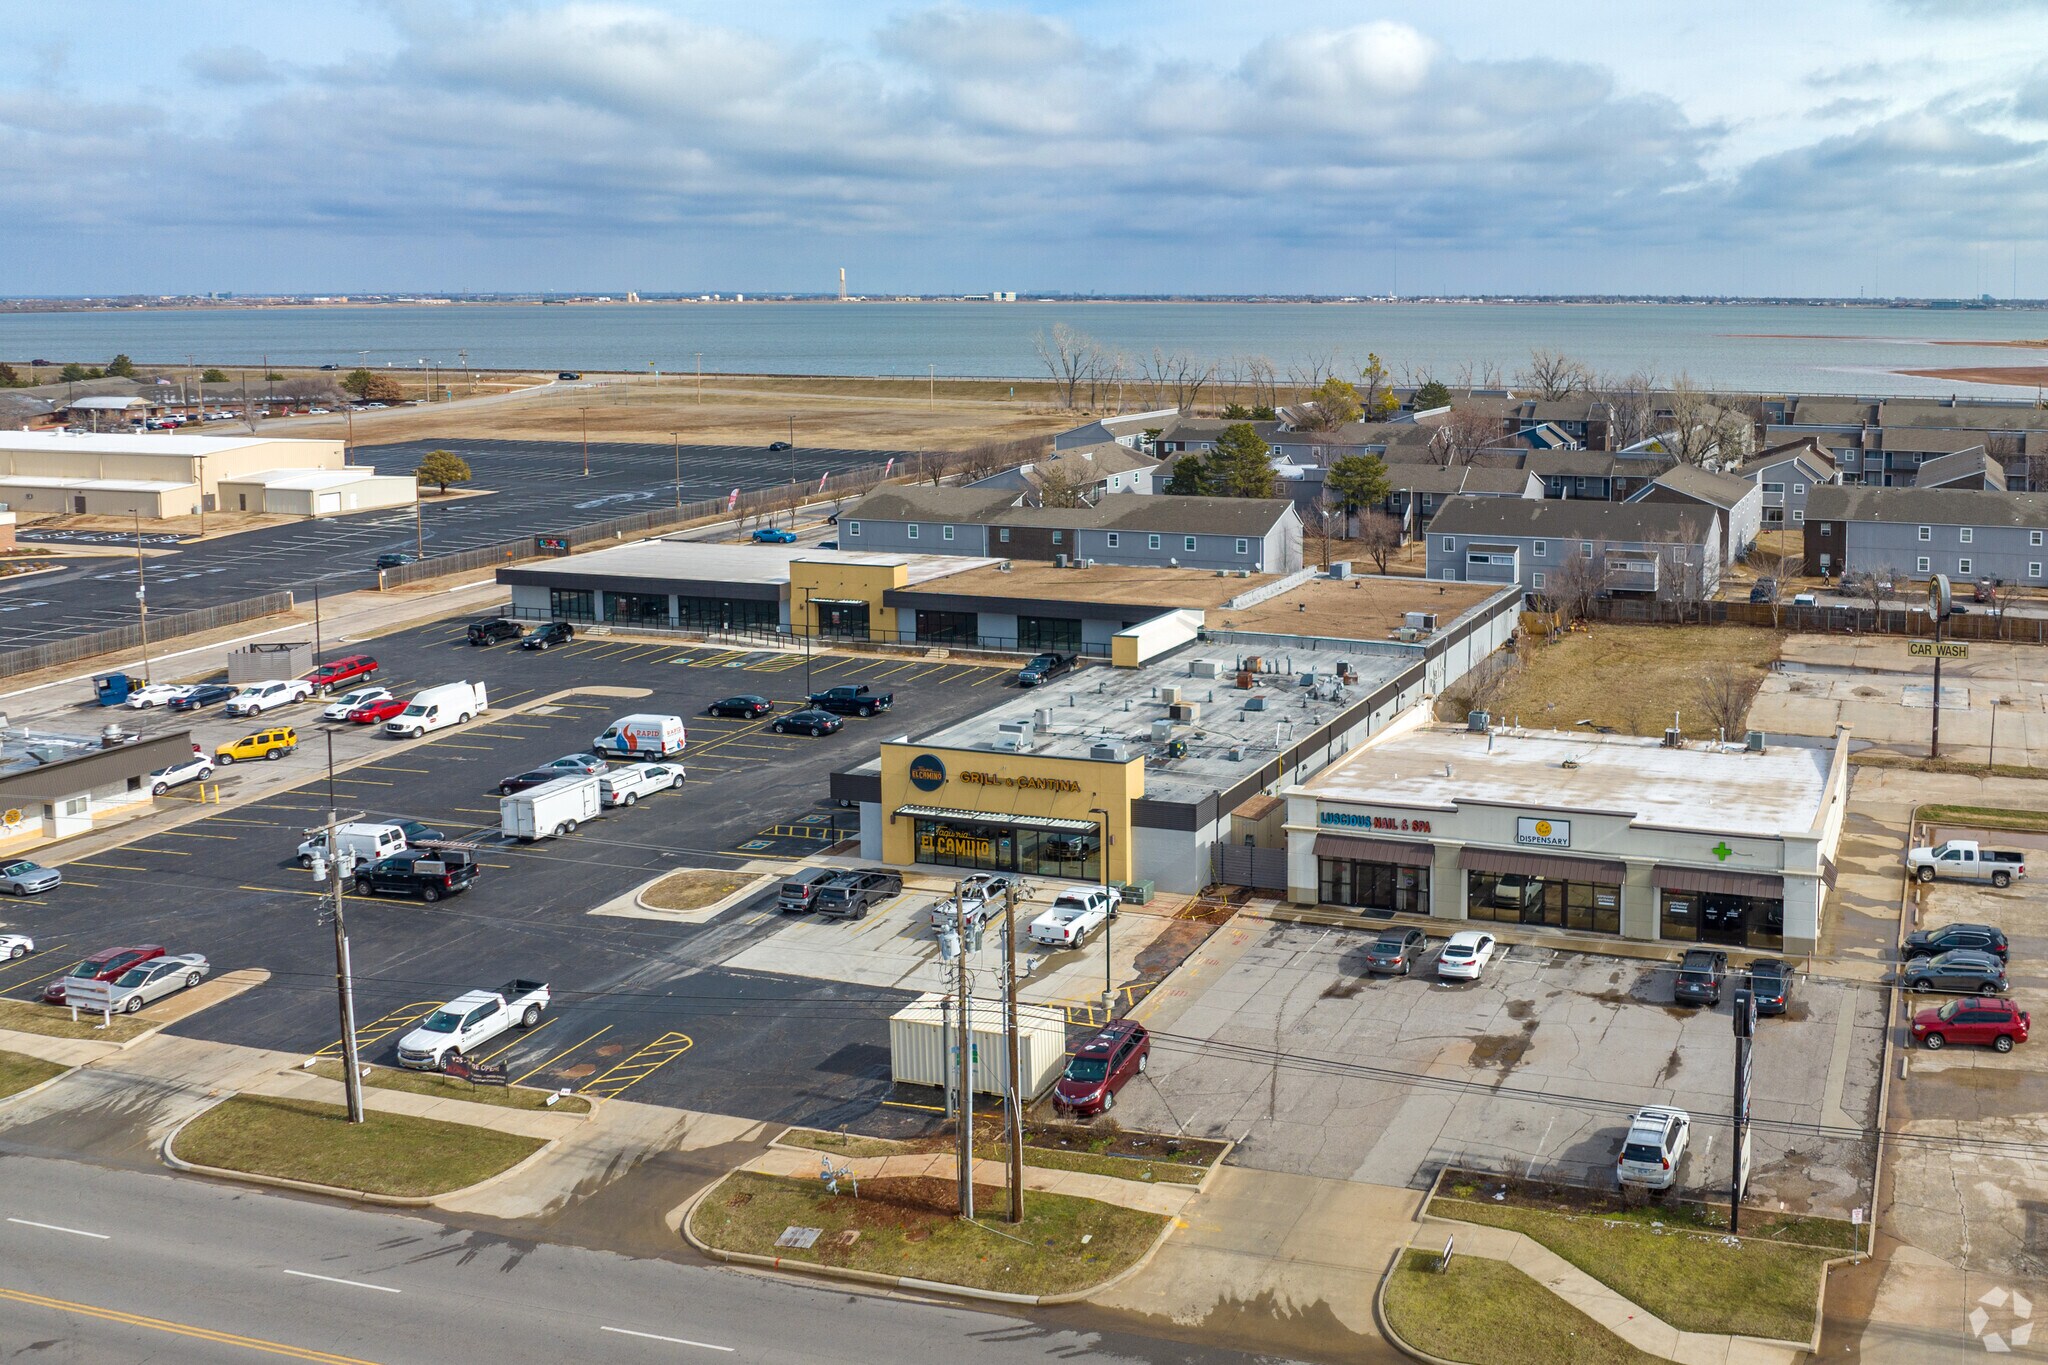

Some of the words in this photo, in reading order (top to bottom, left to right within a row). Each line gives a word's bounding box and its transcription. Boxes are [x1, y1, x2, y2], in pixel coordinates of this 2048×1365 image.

[1910, 644, 1932, 655] CAR
[1936, 645, 1967, 657] WASH
[636, 729, 660, 737] RAPID
[959, 771, 1002, 786] GRILL
[1005, 777, 1014, 787] &
[1016, 775, 1081, 793] CANTINA
[1320, 812, 1371, 827] LUSCIOUS
[1373, 816, 1398, 831] NAIL
[1400, 818, 1409, 831] &
[1411, 819, 1432, 833] SPA
[935, 825, 969, 839] Taquria
[920, 835, 935, 850] EL
[937, 837, 989, 858] CAMINO
[1519, 835, 1568, 845] DISPENSARY
